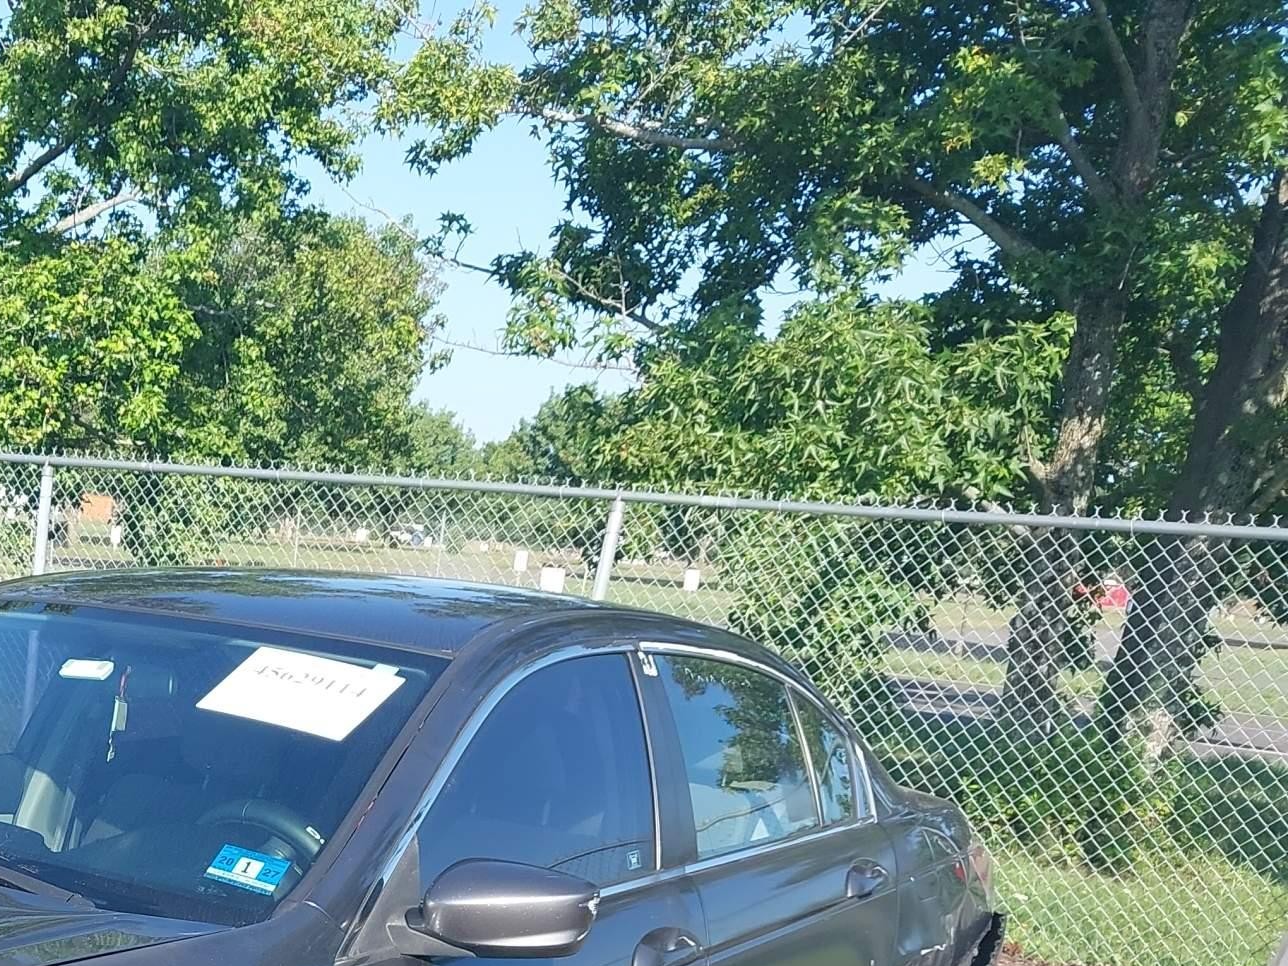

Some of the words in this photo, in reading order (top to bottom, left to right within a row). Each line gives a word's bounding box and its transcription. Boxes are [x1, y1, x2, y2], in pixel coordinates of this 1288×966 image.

[218, 855, 234, 866] 20
[240, 861, 252, 874] 1
[261, 868, 281, 879] 27
